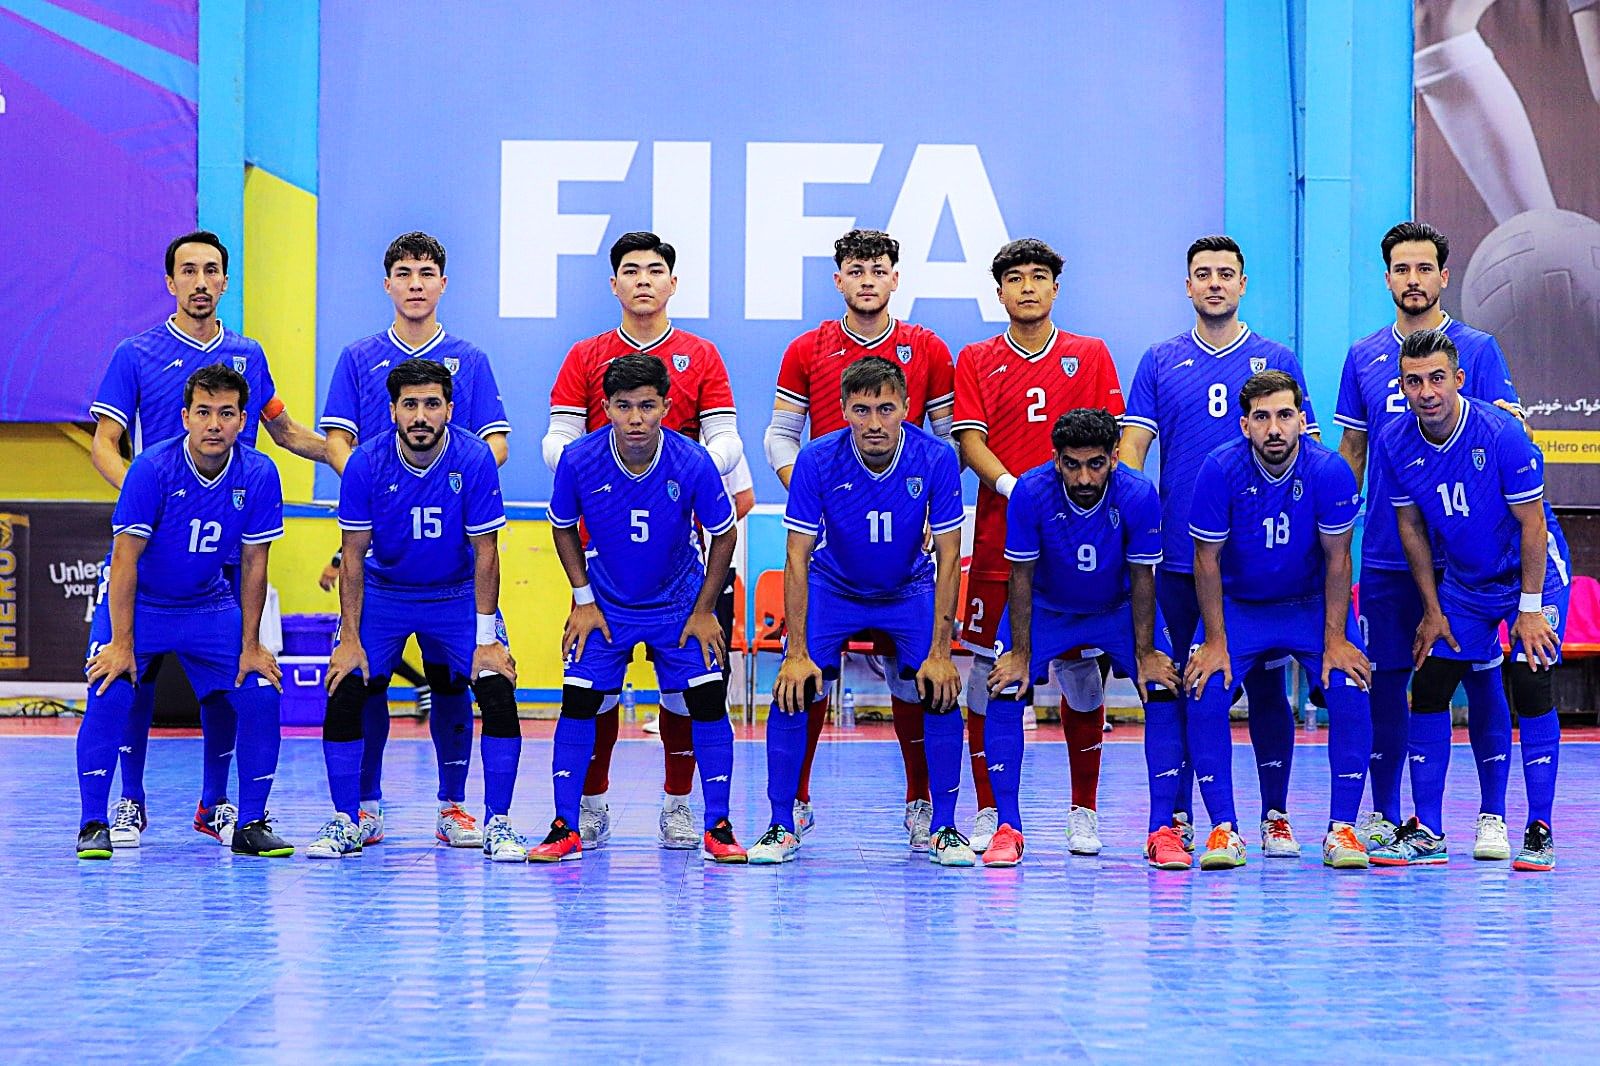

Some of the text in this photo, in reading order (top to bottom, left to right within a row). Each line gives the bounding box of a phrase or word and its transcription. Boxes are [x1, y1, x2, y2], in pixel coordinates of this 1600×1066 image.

[499, 139, 1012, 323] FIFA
[1026, 387, 1047, 423] 2
[1207, 383, 1228, 418] 8
[1436, 482, 1470, 517] 14
[188, 518, 222, 554] 12
[410, 506, 442, 540] 15
[629, 508, 650, 543] 5
[866, 510, 892, 543] 11
[1262, 511, 1290, 549] 18
[1076, 543, 1097, 572] 9
[63, 583, 95, 599] your
[968, 597, 984, 633] 2
